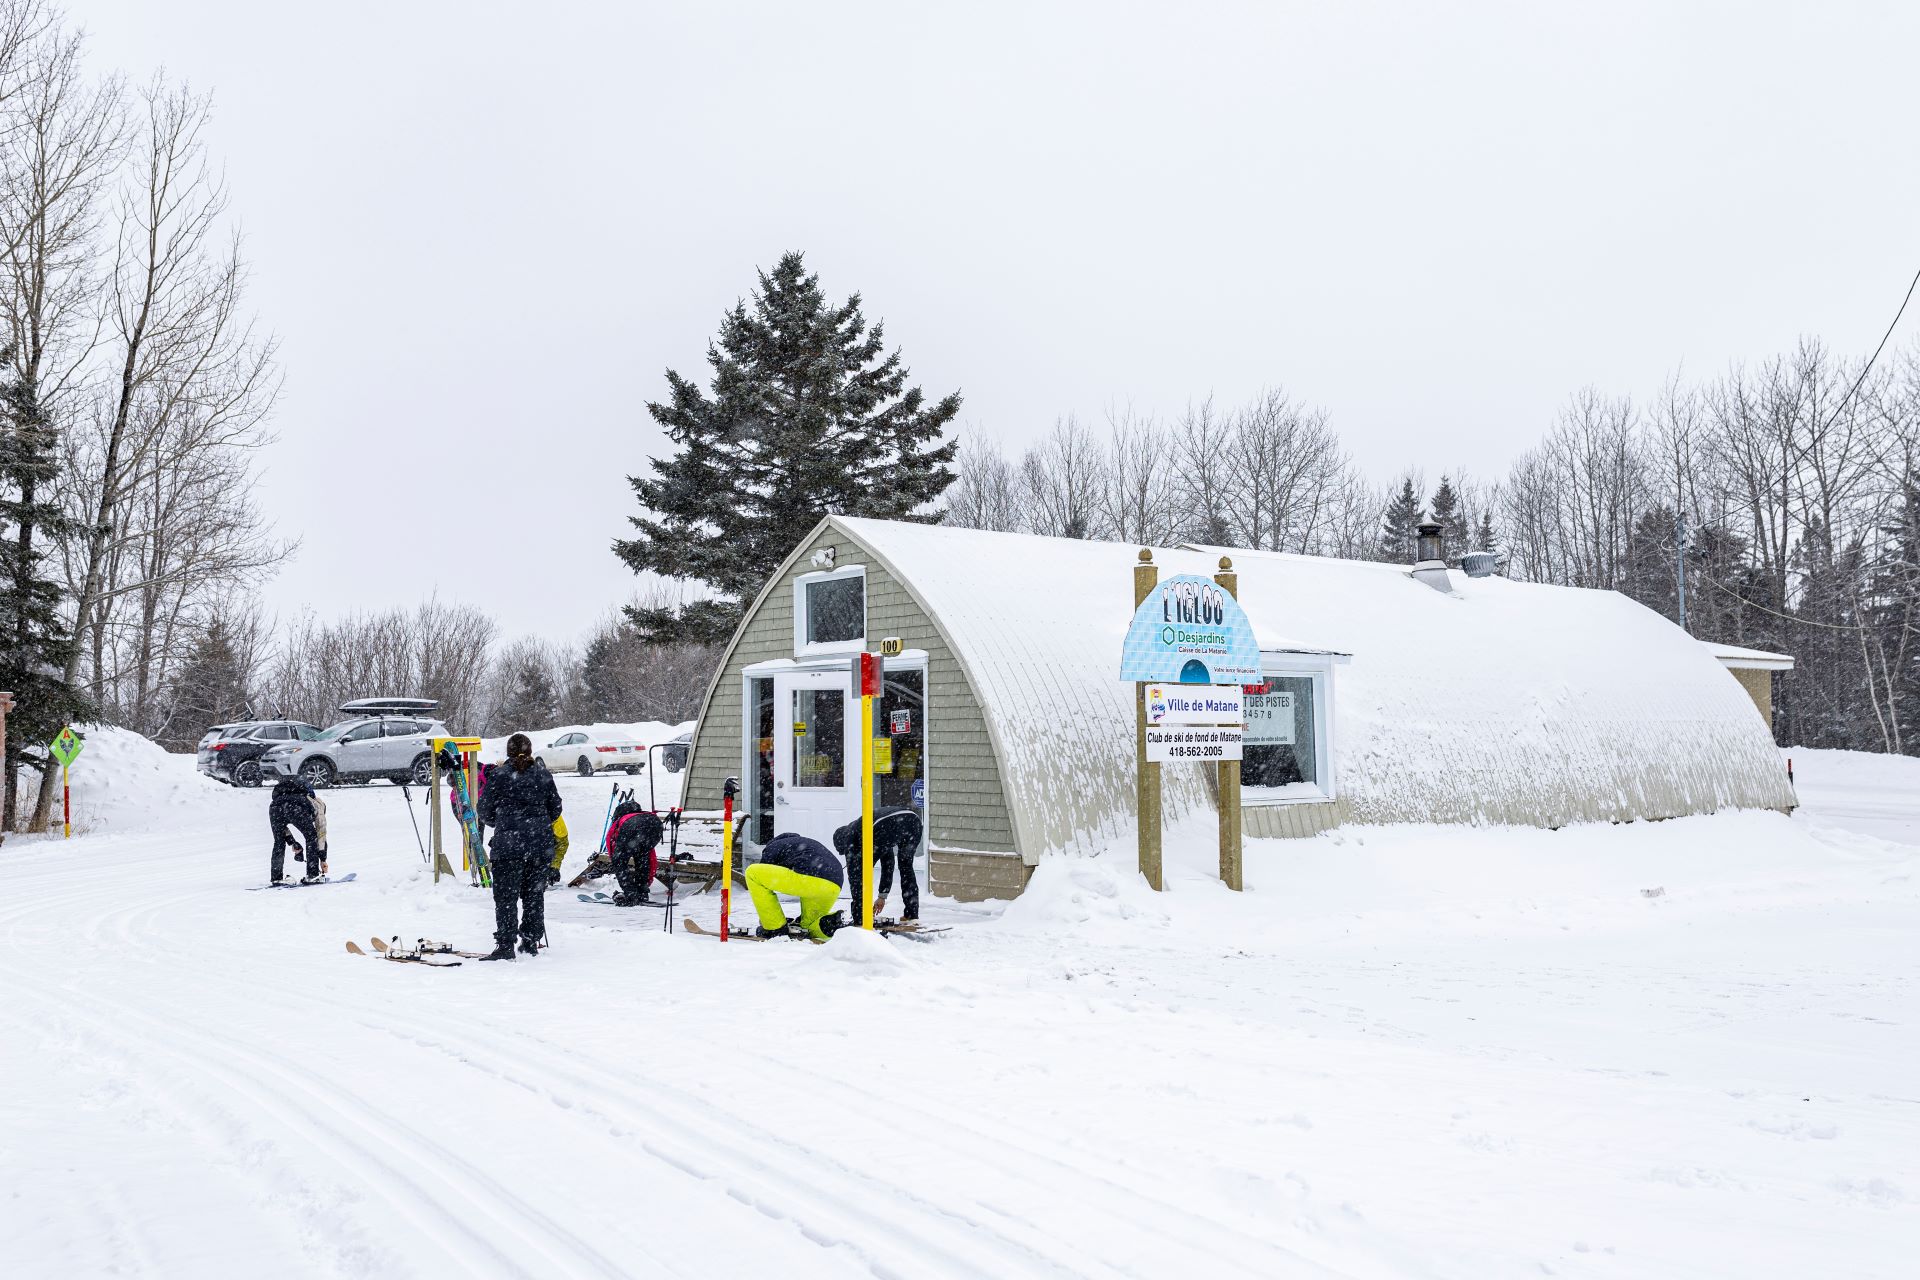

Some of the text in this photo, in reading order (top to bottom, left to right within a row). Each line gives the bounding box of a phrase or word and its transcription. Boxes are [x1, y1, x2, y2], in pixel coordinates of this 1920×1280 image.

[1162, 581, 1223, 625] L'IGLOO
[1178, 631, 1225, 645] Desjardins
[882, 640, 897, 652] 100
[1168, 699, 1239, 712] Ville de Matane
[1250, 697, 1264, 707] DES
[1266, 697, 1290, 707] PISTES
[1248, 710, 1253, 718] 4
[1254, 710, 1259, 719] 5
[1260, 711, 1265, 719] 7
[1267, 711, 1272, 719] 8
[63, 730, 70, 739] A
[1147, 732, 1242, 743] Club de ski de fond de Matane
[1169, 746, 1223, 757] 418-562-2005
[914, 788, 925, 799] AD
